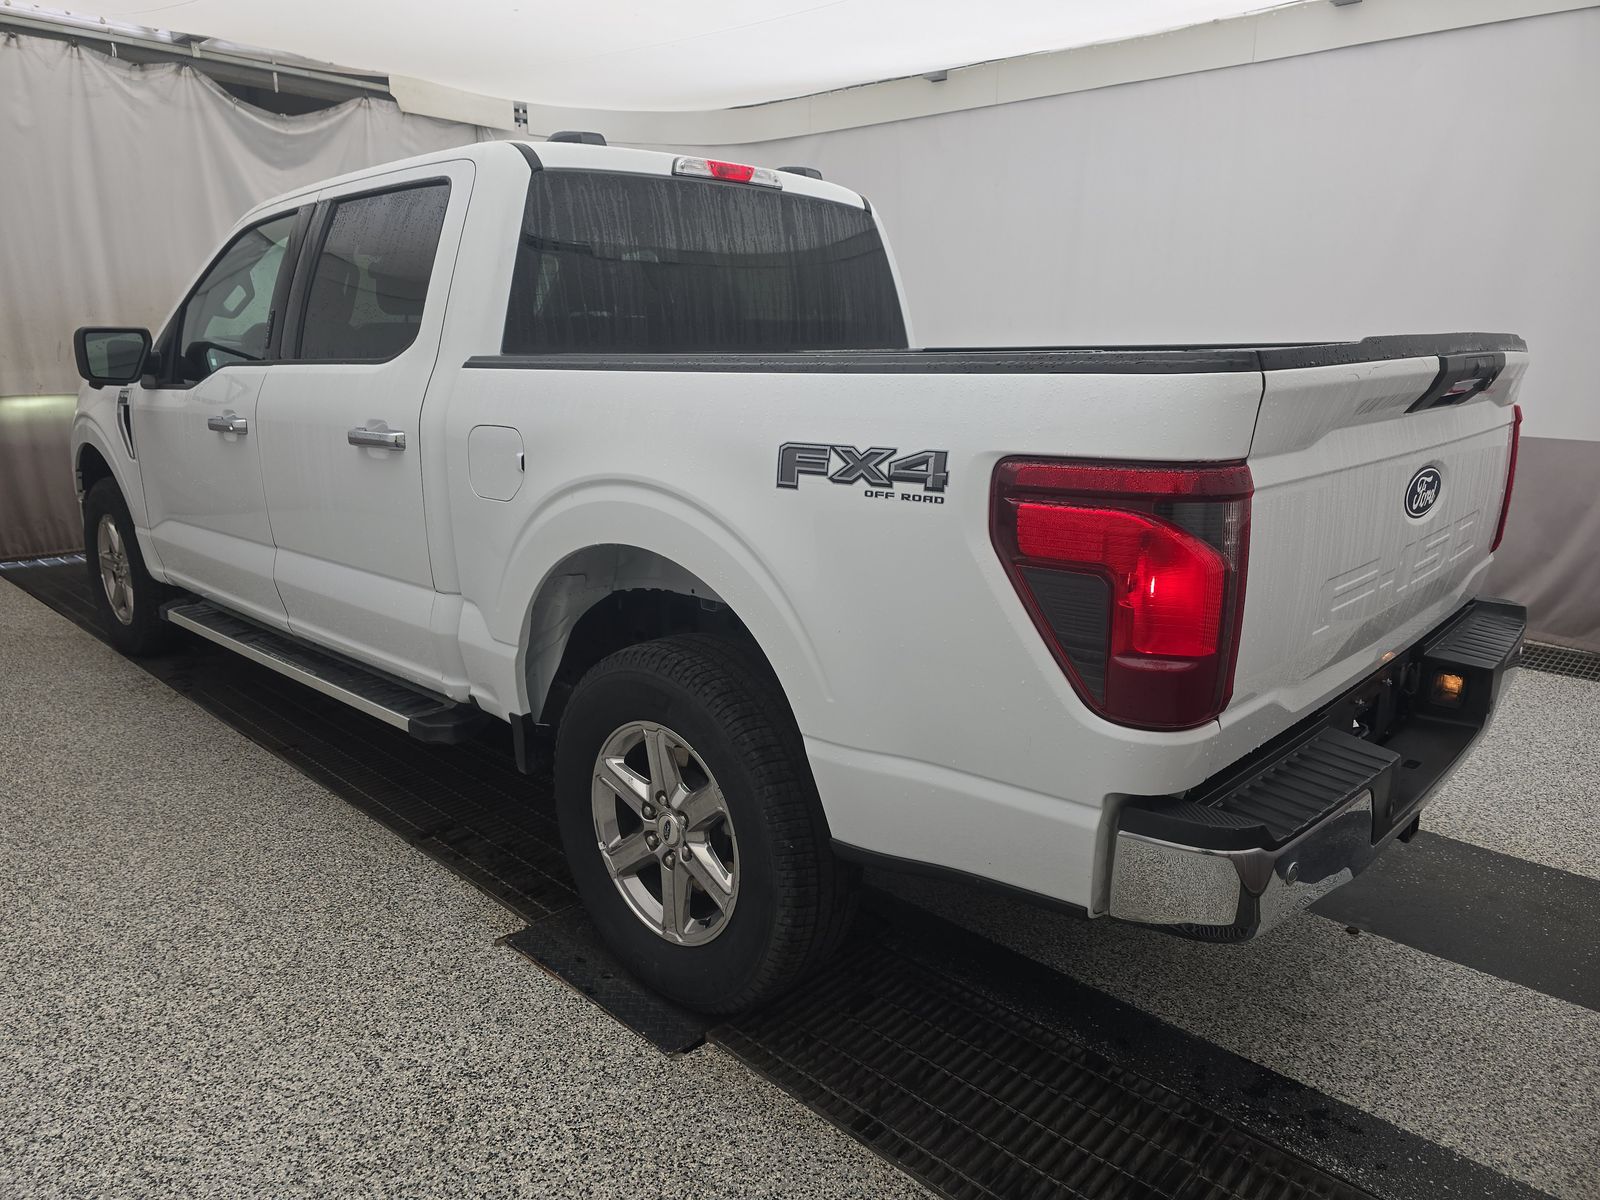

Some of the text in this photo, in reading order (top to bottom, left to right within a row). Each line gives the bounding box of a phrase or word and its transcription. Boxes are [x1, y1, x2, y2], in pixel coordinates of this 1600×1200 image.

[776, 441, 949, 493] FX4
[864, 490, 945, 504] OFF ROAD
[1413, 475, 1438, 510] Ford
